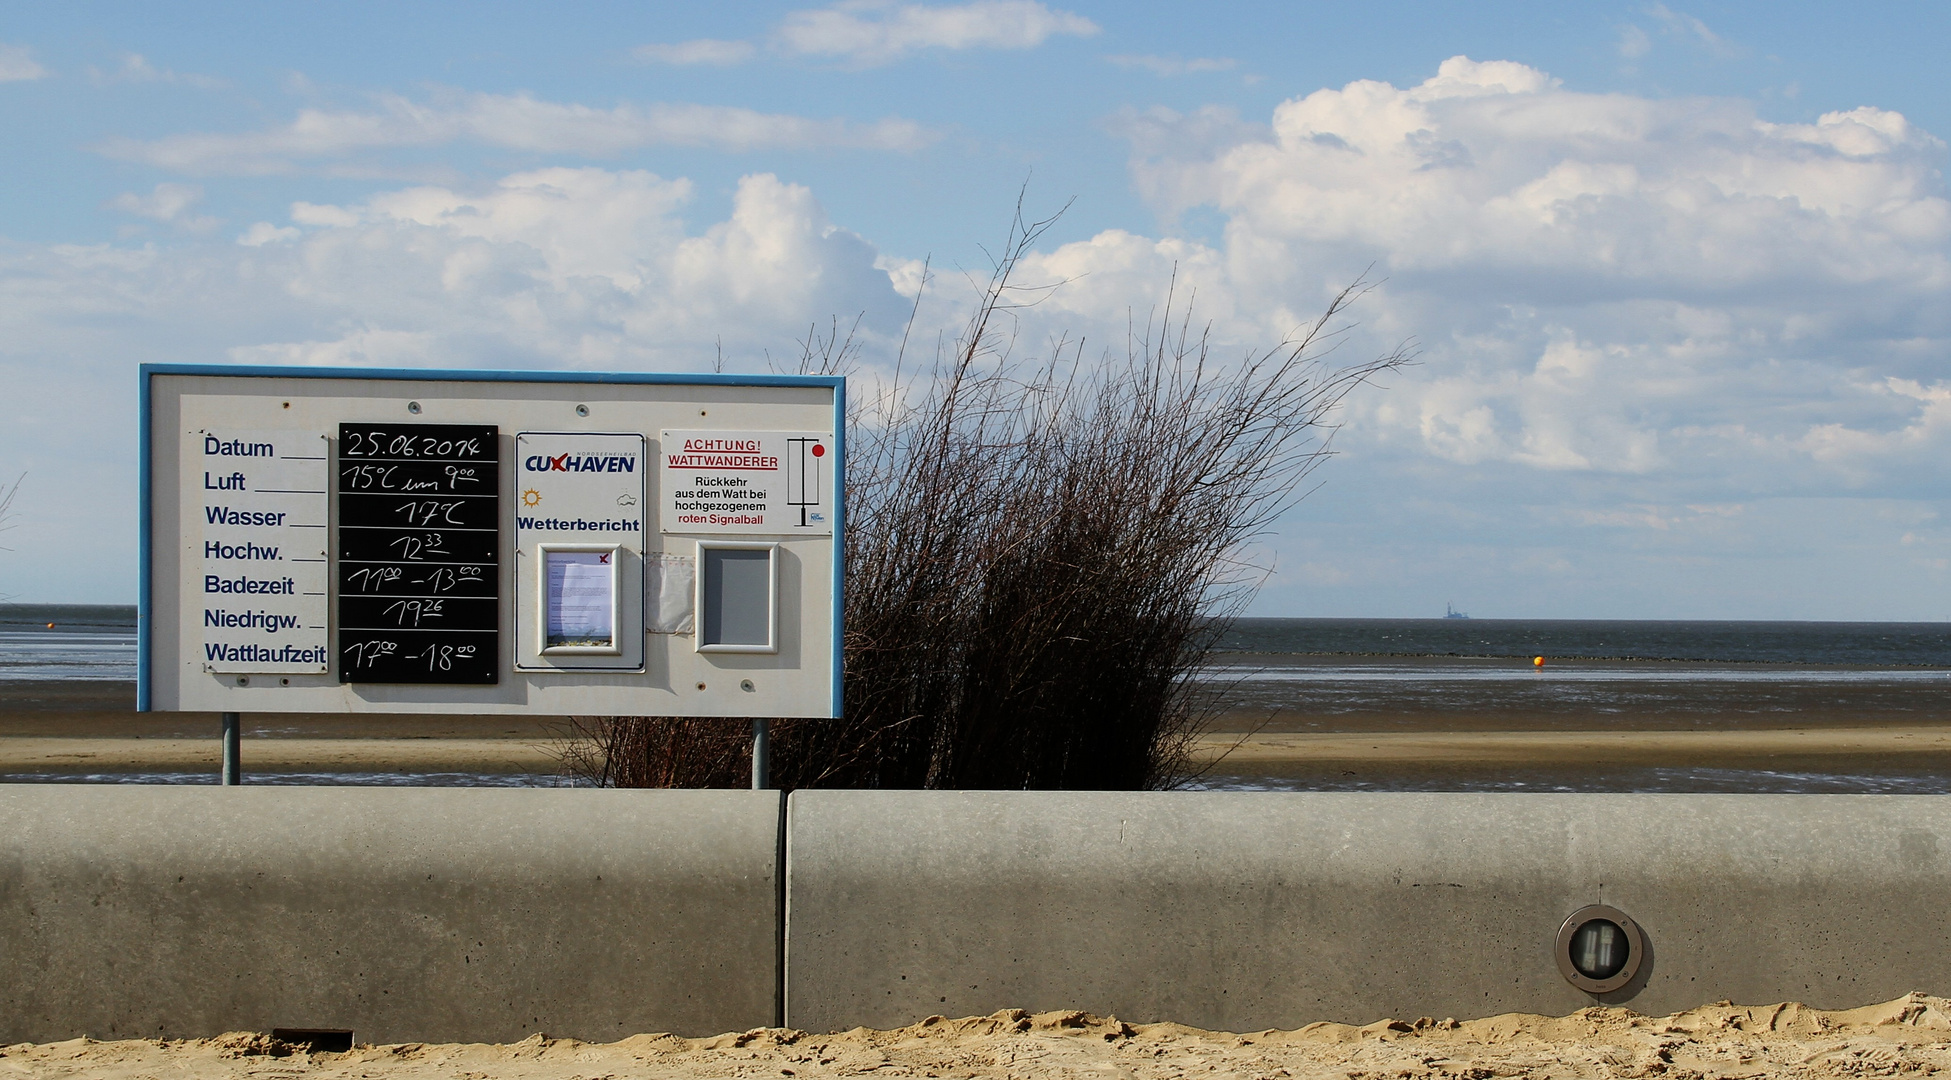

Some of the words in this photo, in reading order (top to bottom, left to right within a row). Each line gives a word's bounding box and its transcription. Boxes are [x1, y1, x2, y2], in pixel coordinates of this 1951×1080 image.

[205, 437, 274, 458] Datum
[347, 431, 481, 457] 25.06.2014
[684, 439, 761, 451] ACHTUNG!
[525, 453, 636, 473] CUXHAVEN
[668, 455, 778, 467] WATTWANDERER
[205, 471, 246, 491] Luft
[695, 476, 748, 487] Rückkehr
[675, 490, 695, 499] aus
[696, 489, 721, 499] dem
[722, 489, 748, 499] Watt
[749, 489, 767, 499] bei
[205, 506, 286, 527] Wasser
[675, 500, 766, 513] hochgezogenem
[518, 517, 640, 532] Wetterbericht
[678, 514, 707, 524] roten
[709, 514, 764, 526] Signalball
[205, 541, 283, 561] Hochw.
[205, 575, 294, 596] Badezeit
[205, 609, 301, 633] Niedrigw.
[205, 643, 327, 664] Wattlaufzeit
